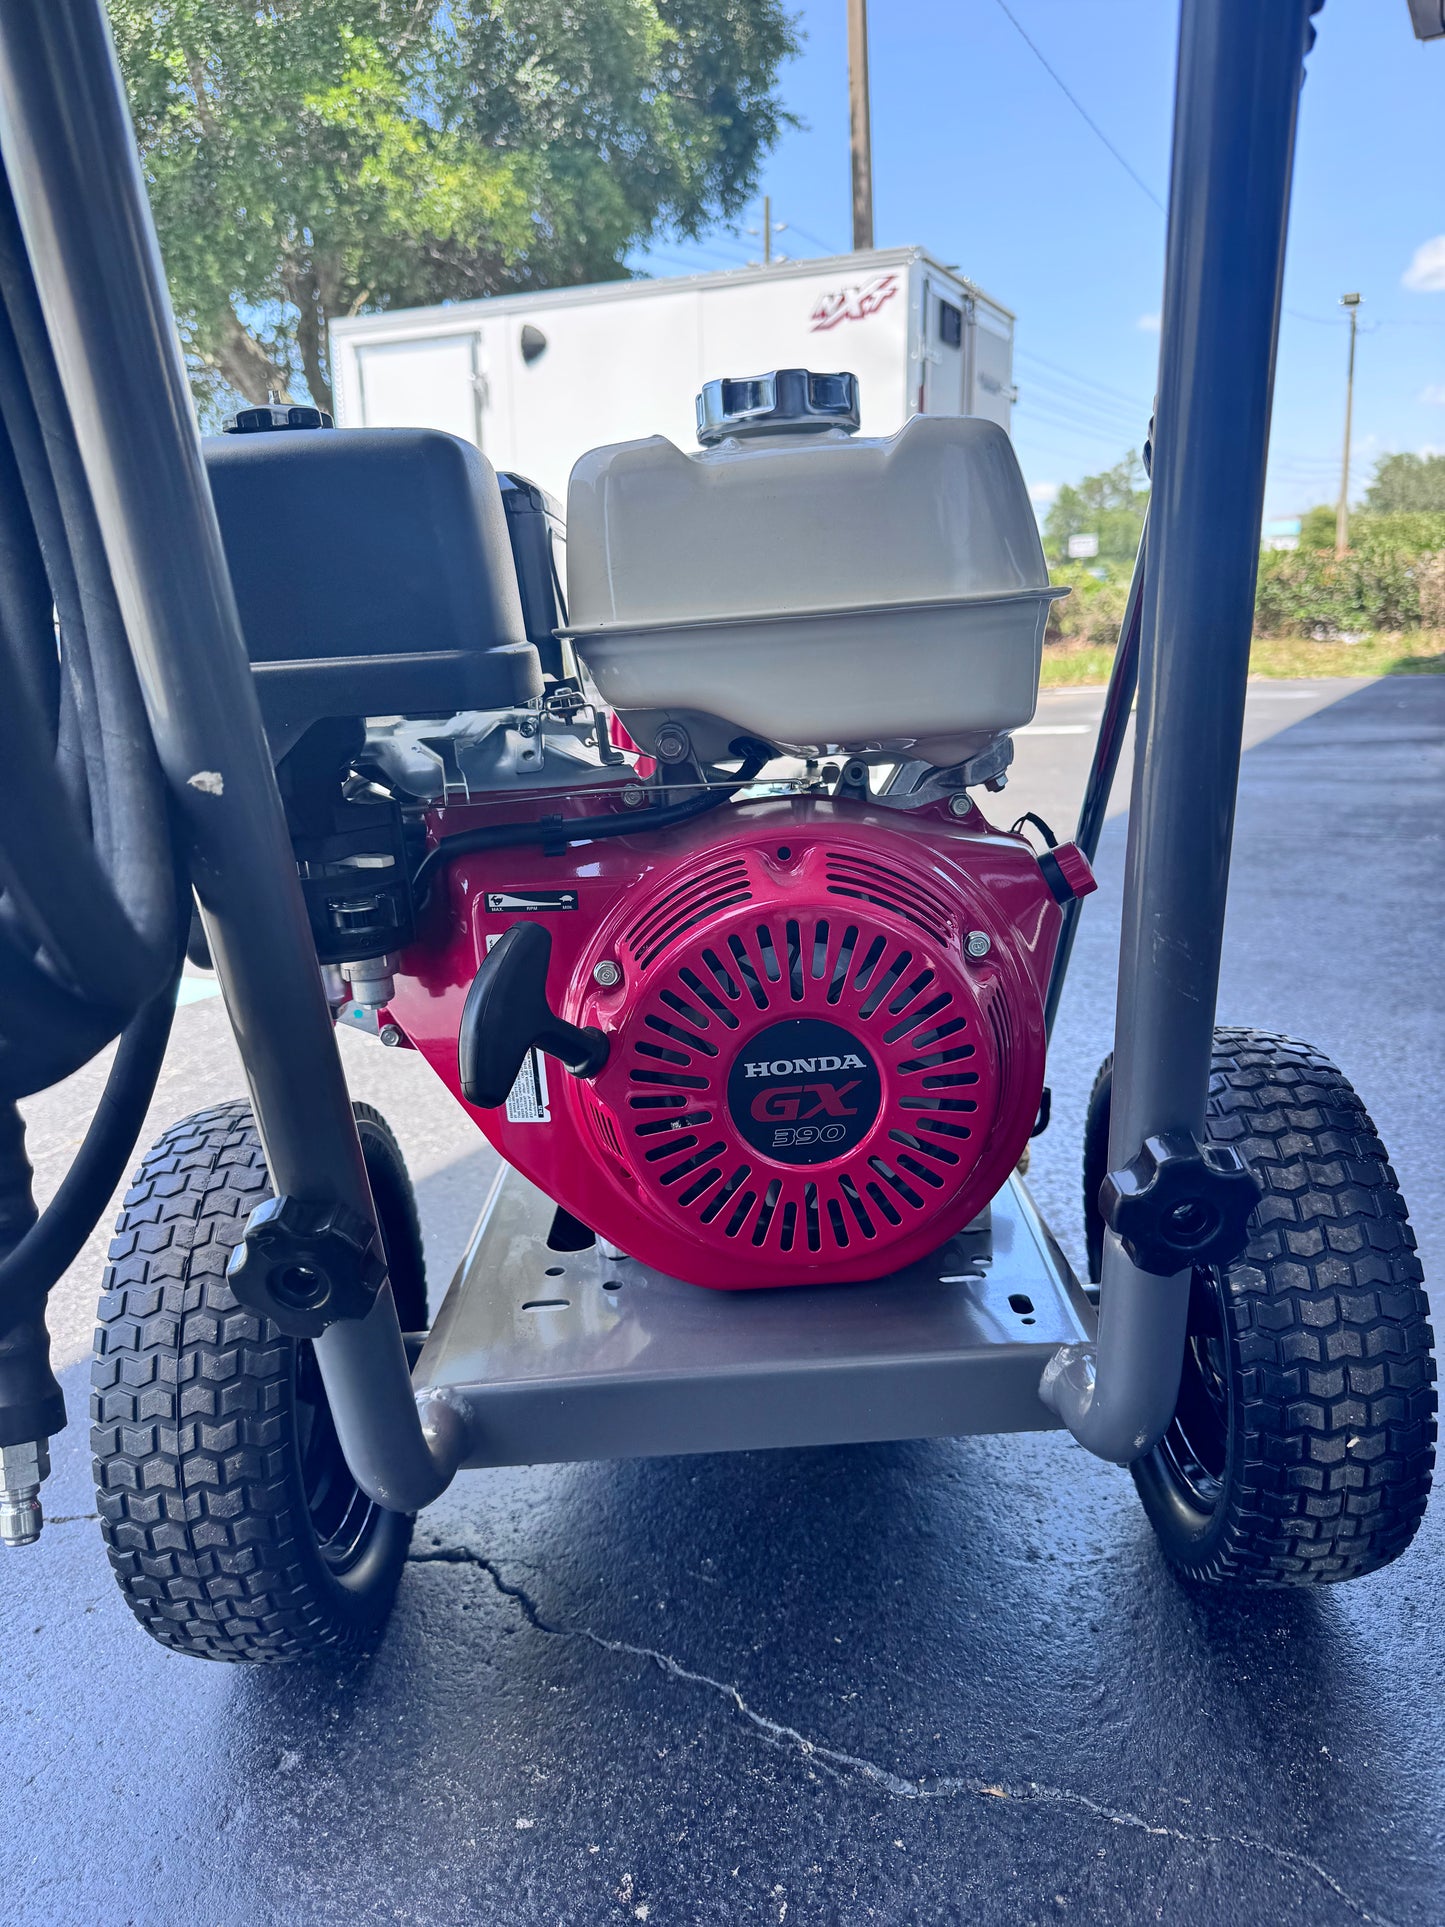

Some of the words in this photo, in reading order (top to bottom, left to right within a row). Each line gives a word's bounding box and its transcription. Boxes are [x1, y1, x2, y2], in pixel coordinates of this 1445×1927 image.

[744, 1054, 867, 1078] HONDA
[751, 1080, 862, 1122] GX
[772, 1123, 846, 1148] 390
